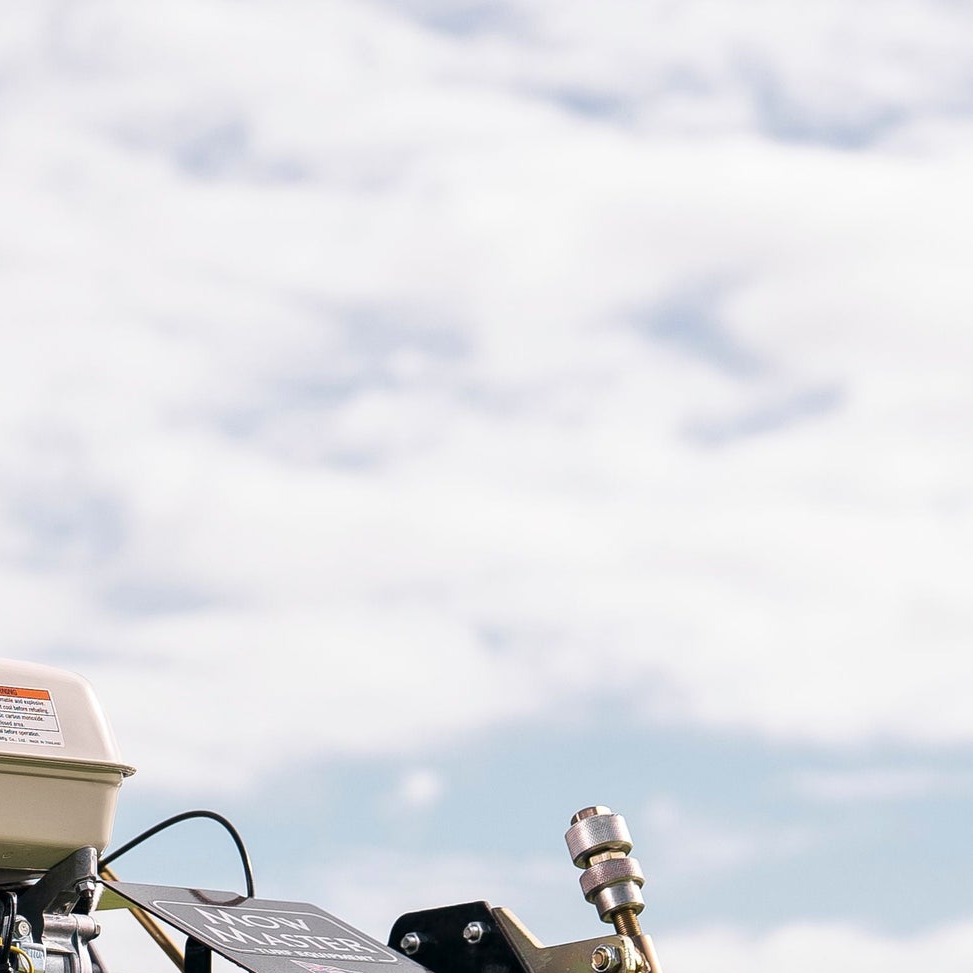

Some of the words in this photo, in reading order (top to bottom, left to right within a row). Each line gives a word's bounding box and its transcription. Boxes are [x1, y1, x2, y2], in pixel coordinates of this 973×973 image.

[194, 907, 311, 931] MOW
[204, 924, 377, 954] MASTER
[254, 947, 291, 956] TURF
[296, 950, 375, 962] EQUIPMENT
